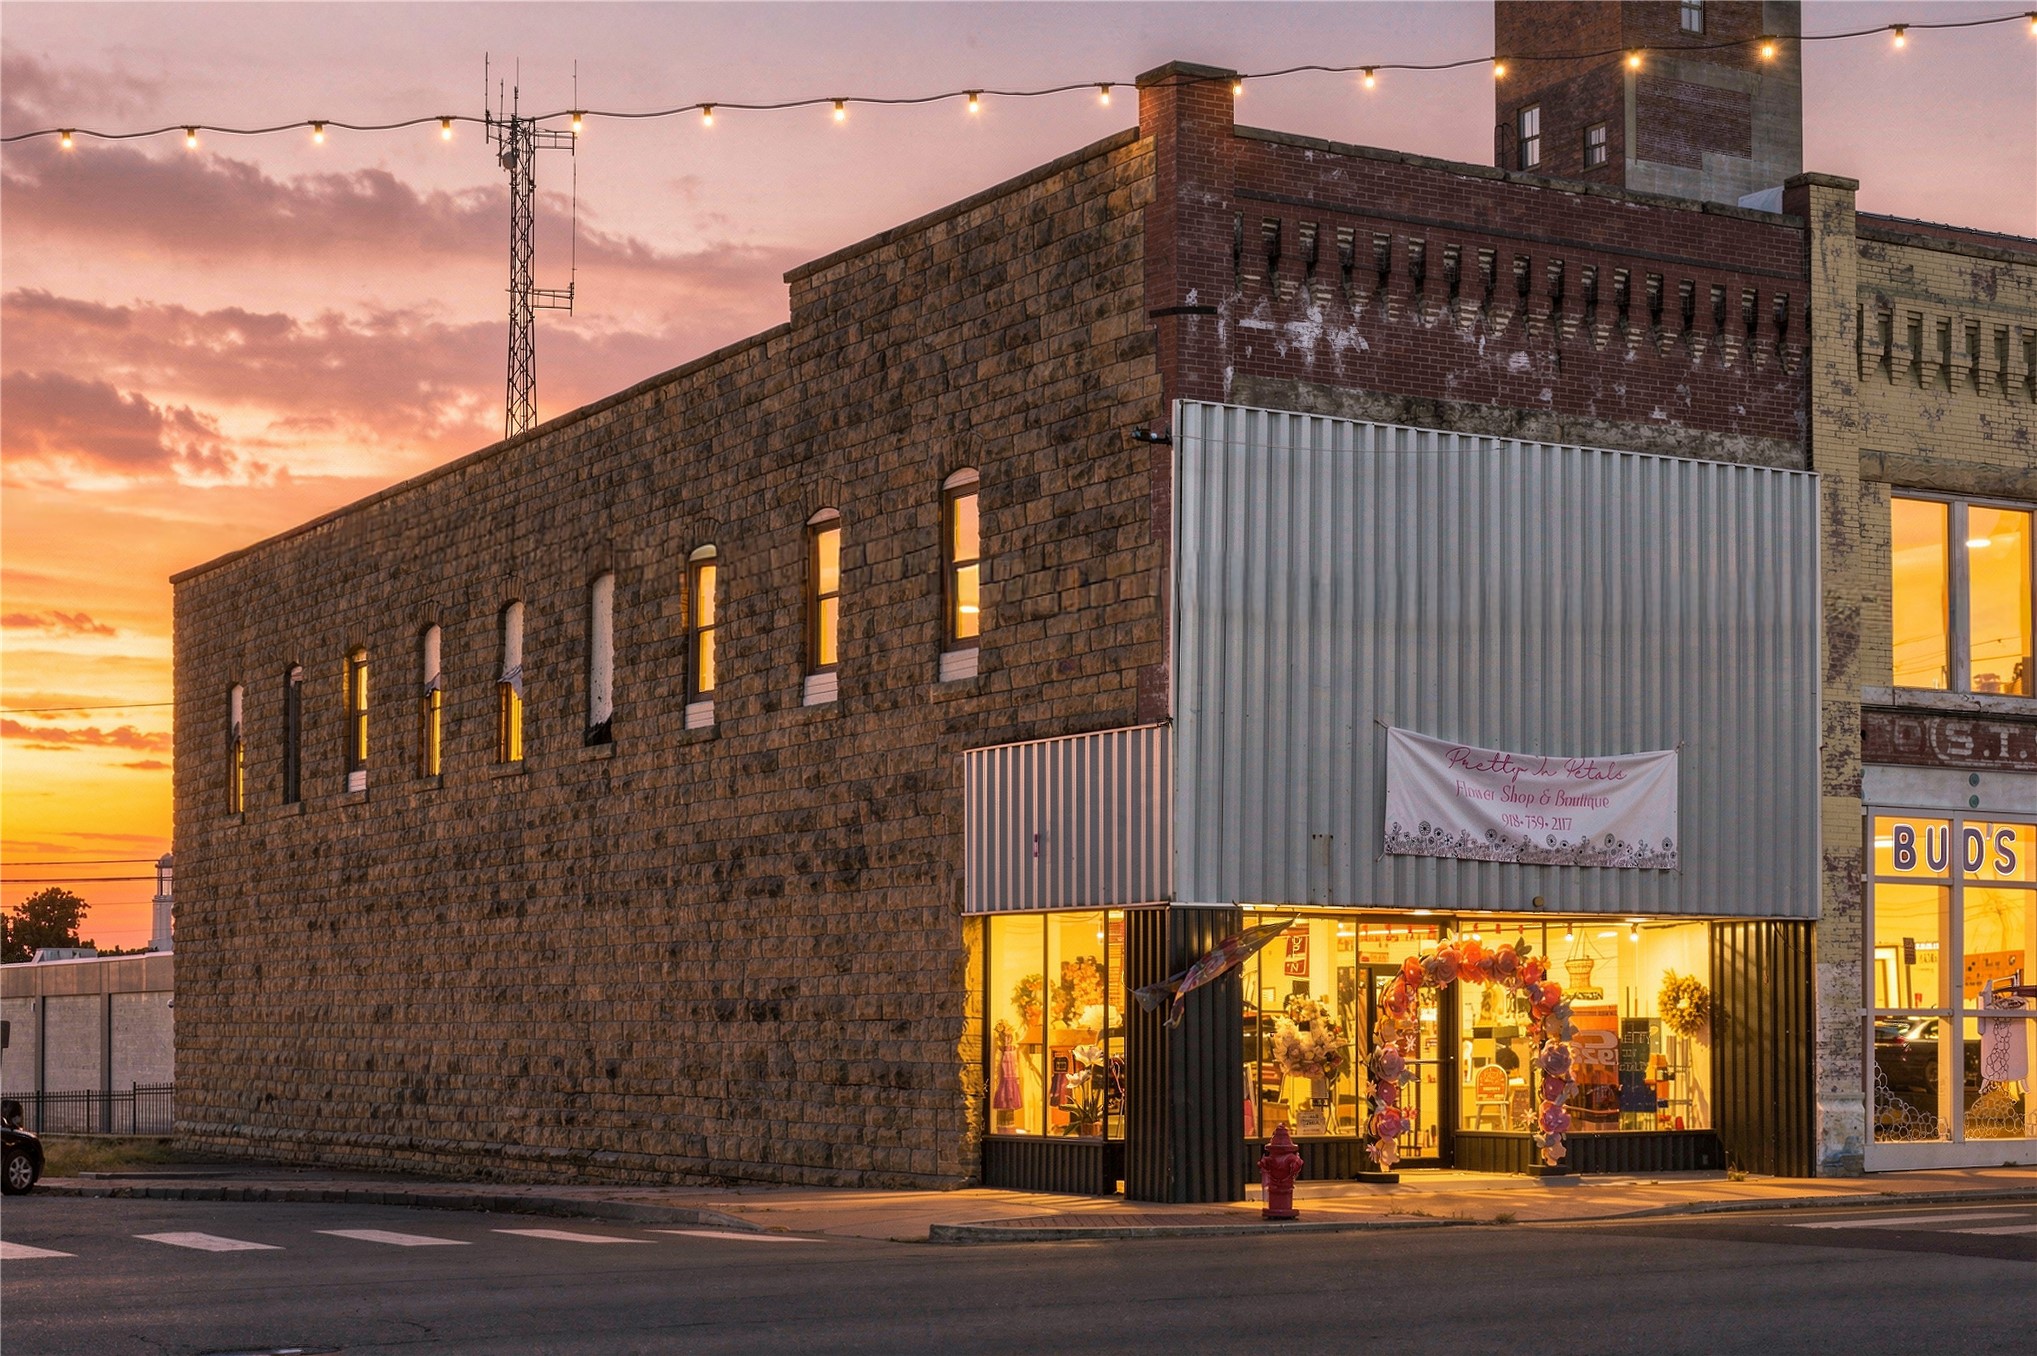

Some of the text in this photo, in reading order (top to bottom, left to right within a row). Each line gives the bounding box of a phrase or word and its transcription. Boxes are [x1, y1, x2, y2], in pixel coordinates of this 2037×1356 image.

[1445, 746, 1627, 783] Pretty In Petals
[1456, 779, 1610, 811] Flower Shop & Boutique
[1892, 823, 2017, 876] BUD'S
